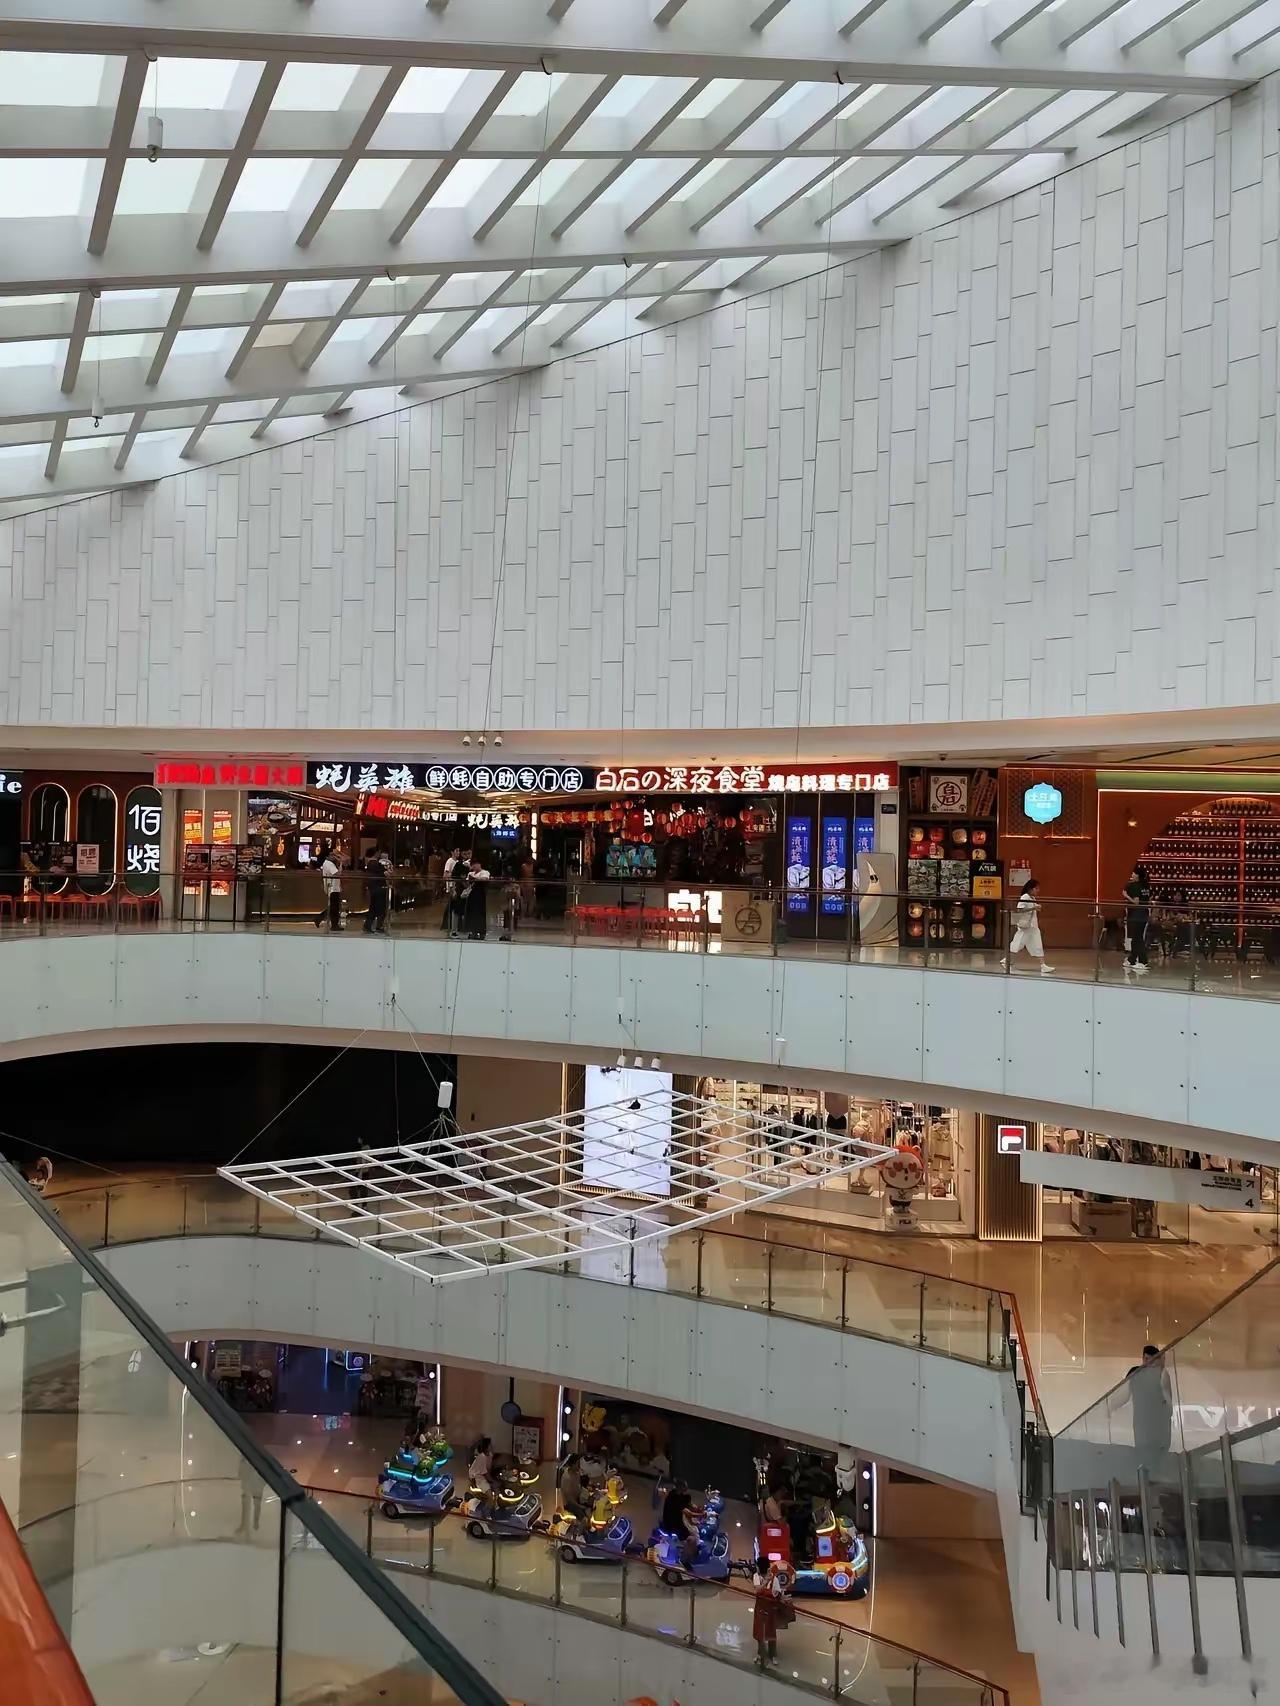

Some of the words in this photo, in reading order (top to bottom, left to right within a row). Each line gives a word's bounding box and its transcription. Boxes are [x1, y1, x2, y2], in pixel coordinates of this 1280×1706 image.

[426, 766, 583, 792] 鲜蚝自助专门店
[596, 766, 764, 793] 白石の深夜食堂
[1245, 1199, 1254, 1209] 4
